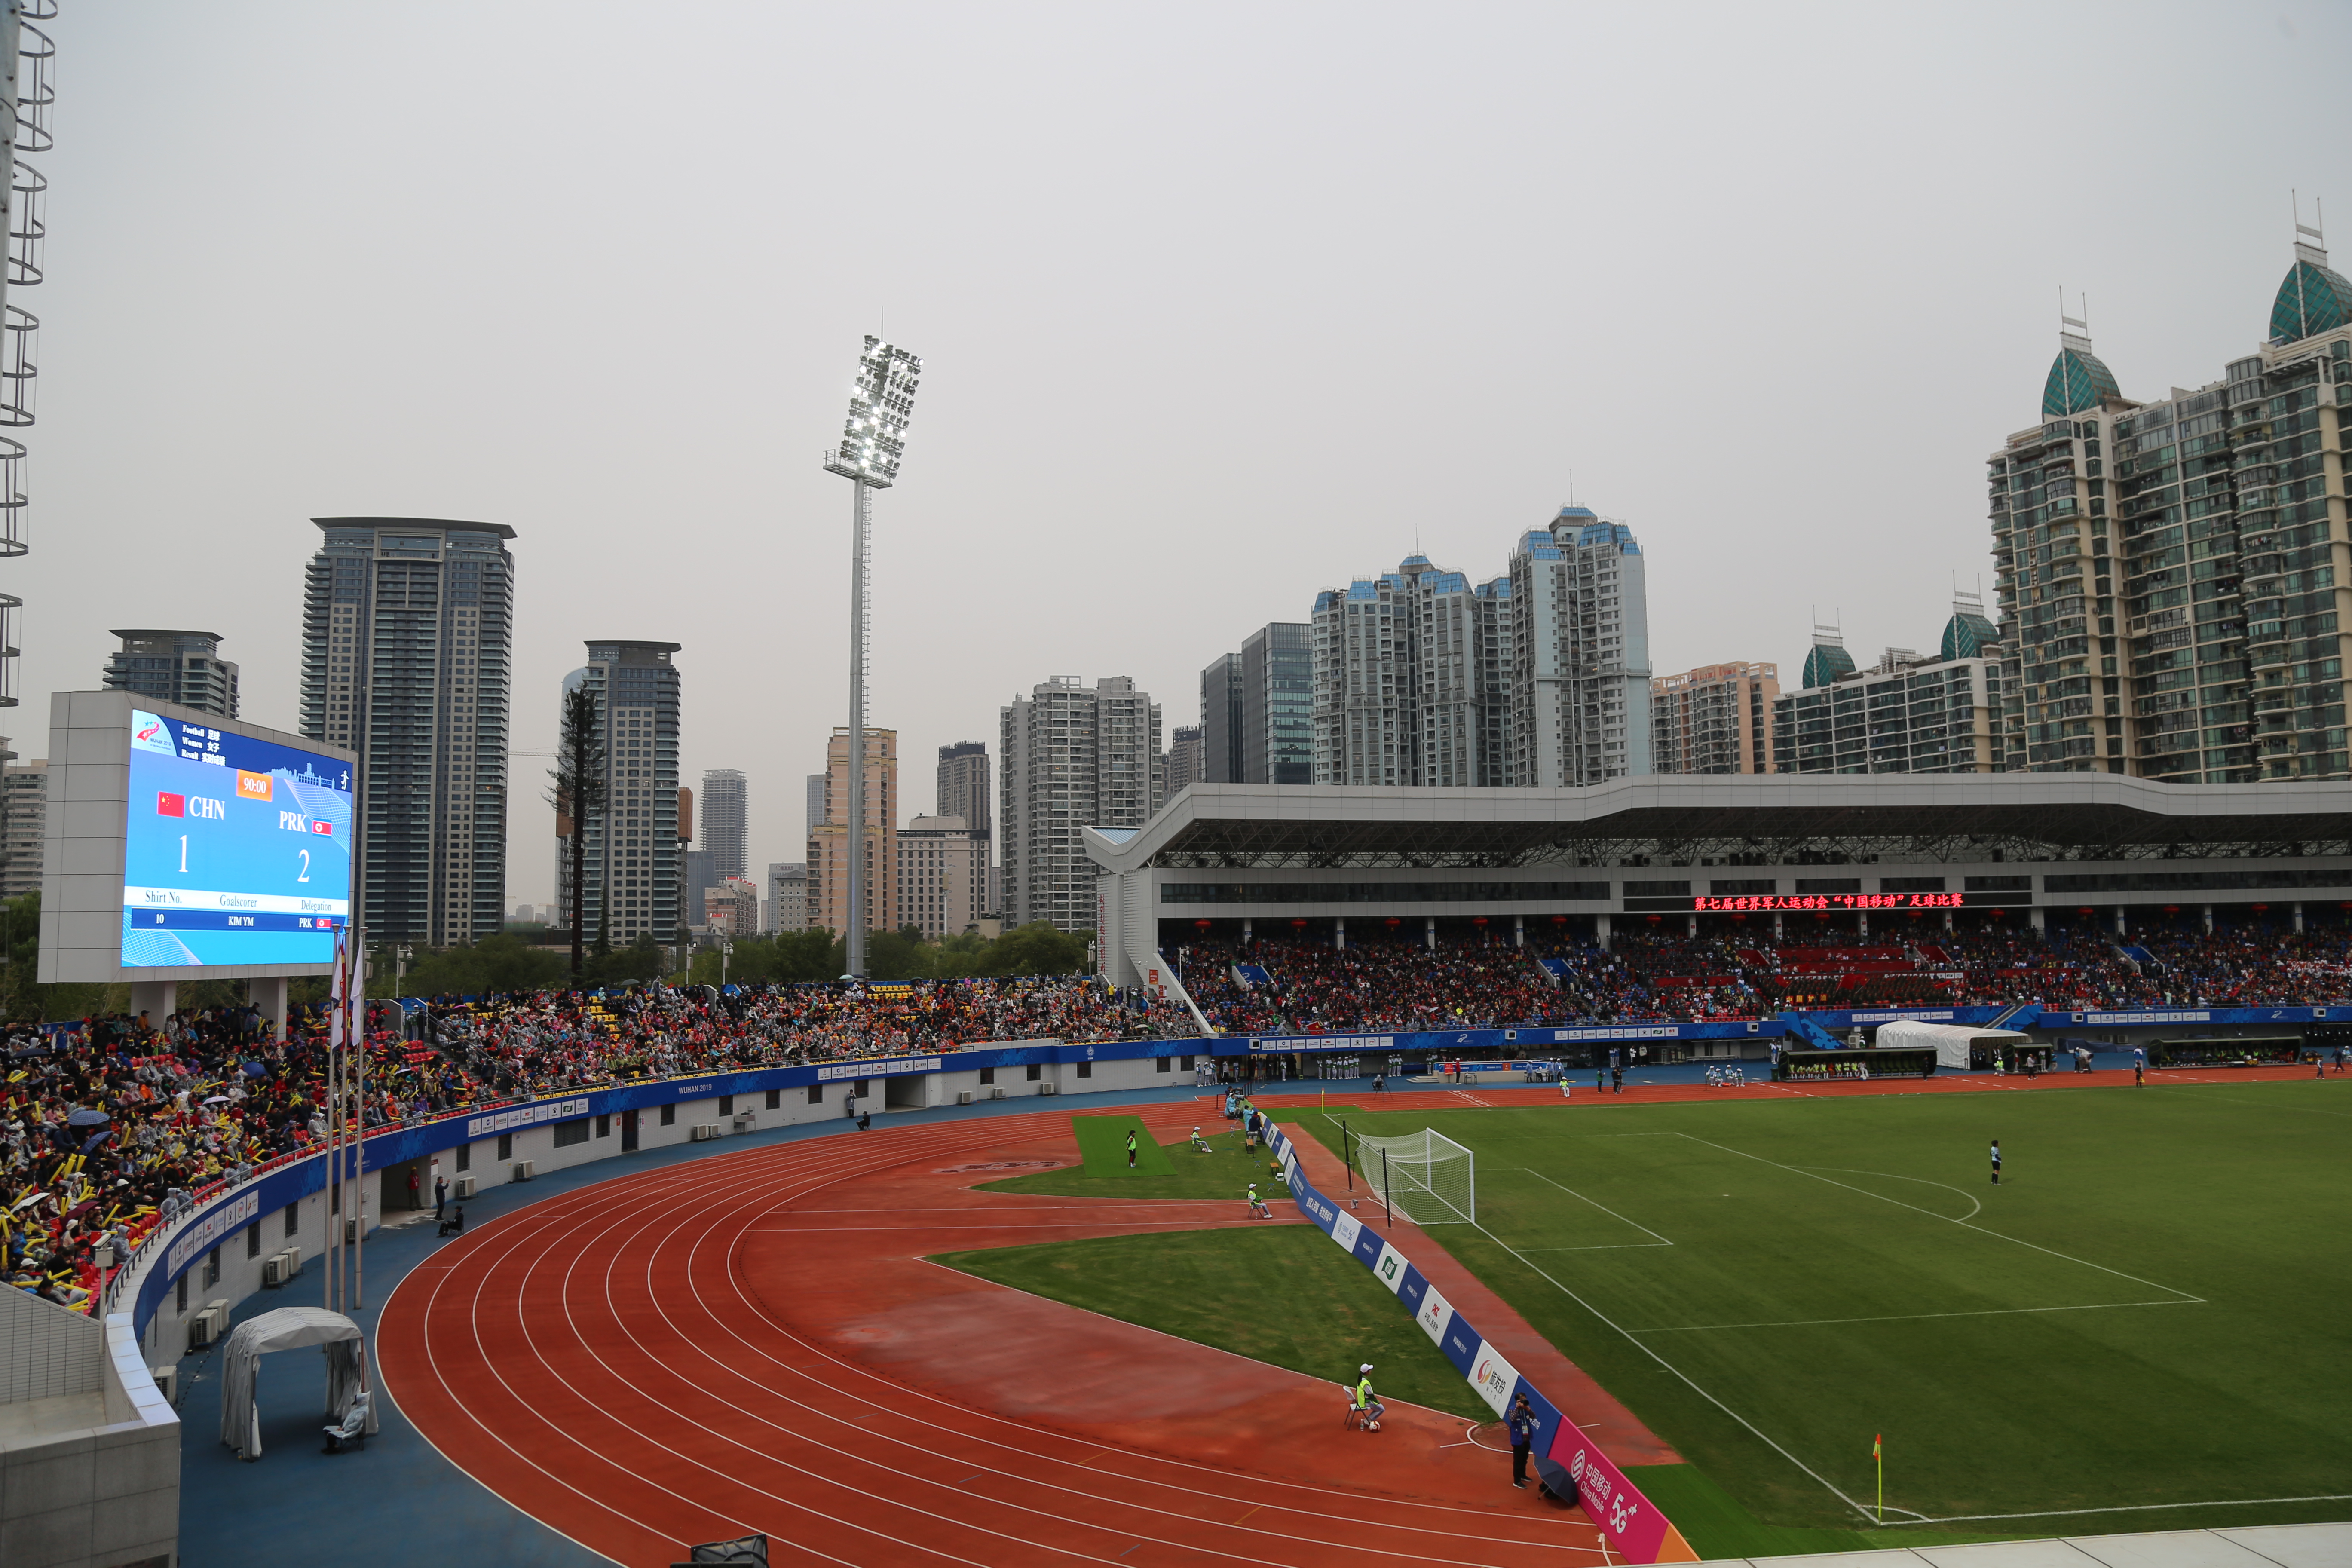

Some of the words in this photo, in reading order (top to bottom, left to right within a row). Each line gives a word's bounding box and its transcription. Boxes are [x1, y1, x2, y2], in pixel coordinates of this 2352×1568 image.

[182, 724, 205, 737] Football
[207, 729, 220, 741] 足球
[182, 737, 203, 749] Women
[207, 741, 220, 753] 女子
[181, 749, 199, 760] Result
[202, 753, 226, 766] 实时成绩
[244, 778, 266, 793] 90:00
[189, 796, 225, 821] CHN
[279, 810, 307, 833] PRK
[178, 835, 188, 873] 1
[297, 849, 309, 882] 2
[145, 890, 167, 903] Shirt
[168, 892, 182, 904] No.
[220, 894, 257, 908] Goalscorer
[301, 899, 331, 912] Delegation
[156, 913, 165, 924] 10
[228, 916, 242, 926] KIM
[242, 916, 254, 927] YM
[299, 917, 312, 928] PRK
[679, 1085, 698, 1094] WUHAN
[700, 1084, 712, 1092] 2019
[1431, 1303, 1440, 1317] PICC
[1489, 1370, 1506, 1396] 旅发投
[1531, 1418, 1540, 1430] 2019
[1586, 1463, 1611, 1500] 中国移动
[1580, 1481, 1592, 1500] China
[1590, 1492, 1605, 1514] Mobile
